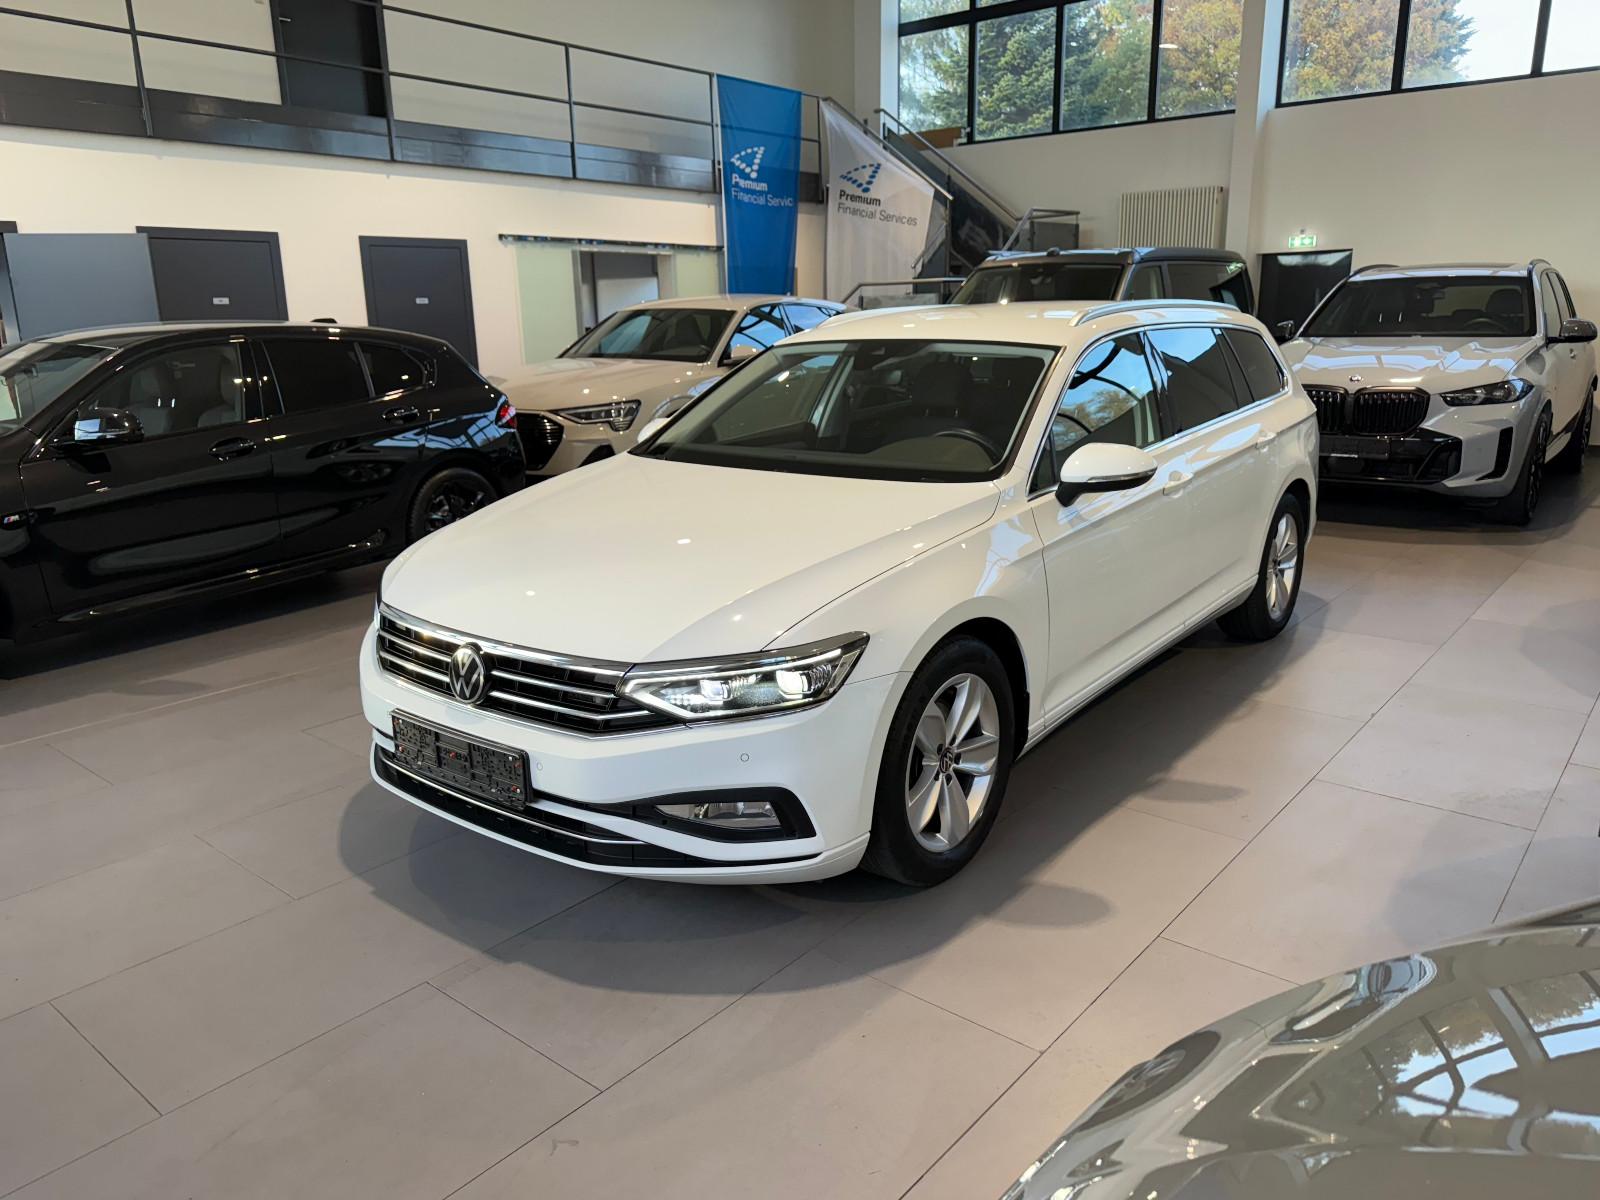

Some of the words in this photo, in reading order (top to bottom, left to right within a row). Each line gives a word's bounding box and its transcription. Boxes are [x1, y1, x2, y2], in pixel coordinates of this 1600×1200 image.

[731, 187, 766, 205] Financial
[839, 189, 881, 206] Premium
[837, 202, 877, 220] Financial
[879, 209, 918, 226] Services
